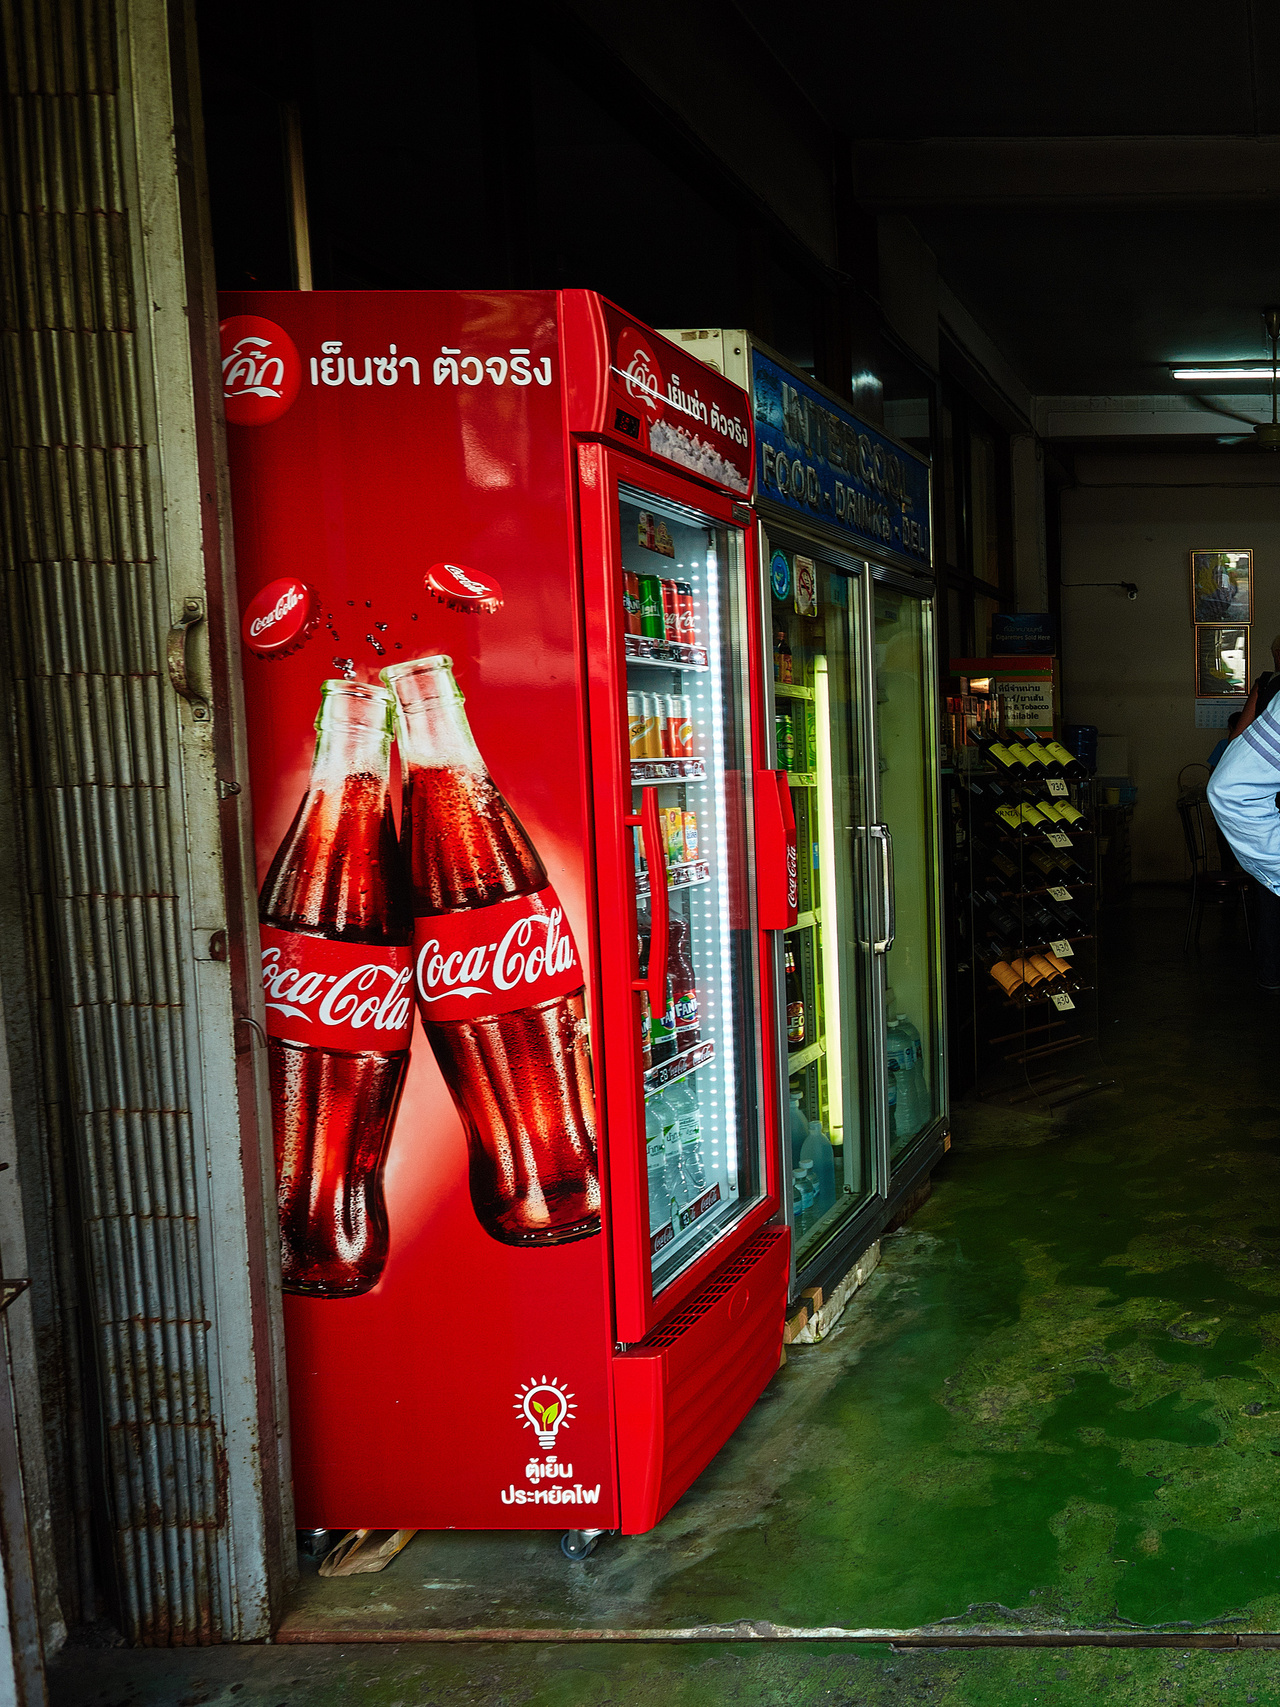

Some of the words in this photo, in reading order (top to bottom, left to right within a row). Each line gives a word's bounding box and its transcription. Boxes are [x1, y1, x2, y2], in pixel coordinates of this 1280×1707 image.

[309, 341, 420, 386] เย็นซ่า
[433, 346, 552, 386] ตัวจริง
[667, 373, 708, 425] เย็นซ่า
[710, 402, 748, 448] ตัวจริง
[762, 442, 820, 506] FOOD
[835, 480, 891, 545] DRINKS
[444, 564, 493, 596] Coca-Cola
[250, 585, 303, 638] Coca-Cola
[998, 683, 1041, 692] ที่นี่จำหน่าย
[1051, 782, 1065, 791] 730
[786, 843, 798, 909] Coca-Cola
[416, 905, 577, 1003] Coca-Cola
[525, 1455, 574, 1485] ตู้เย็น
[500, 1483, 601, 1505] ประหยัดไฟ
